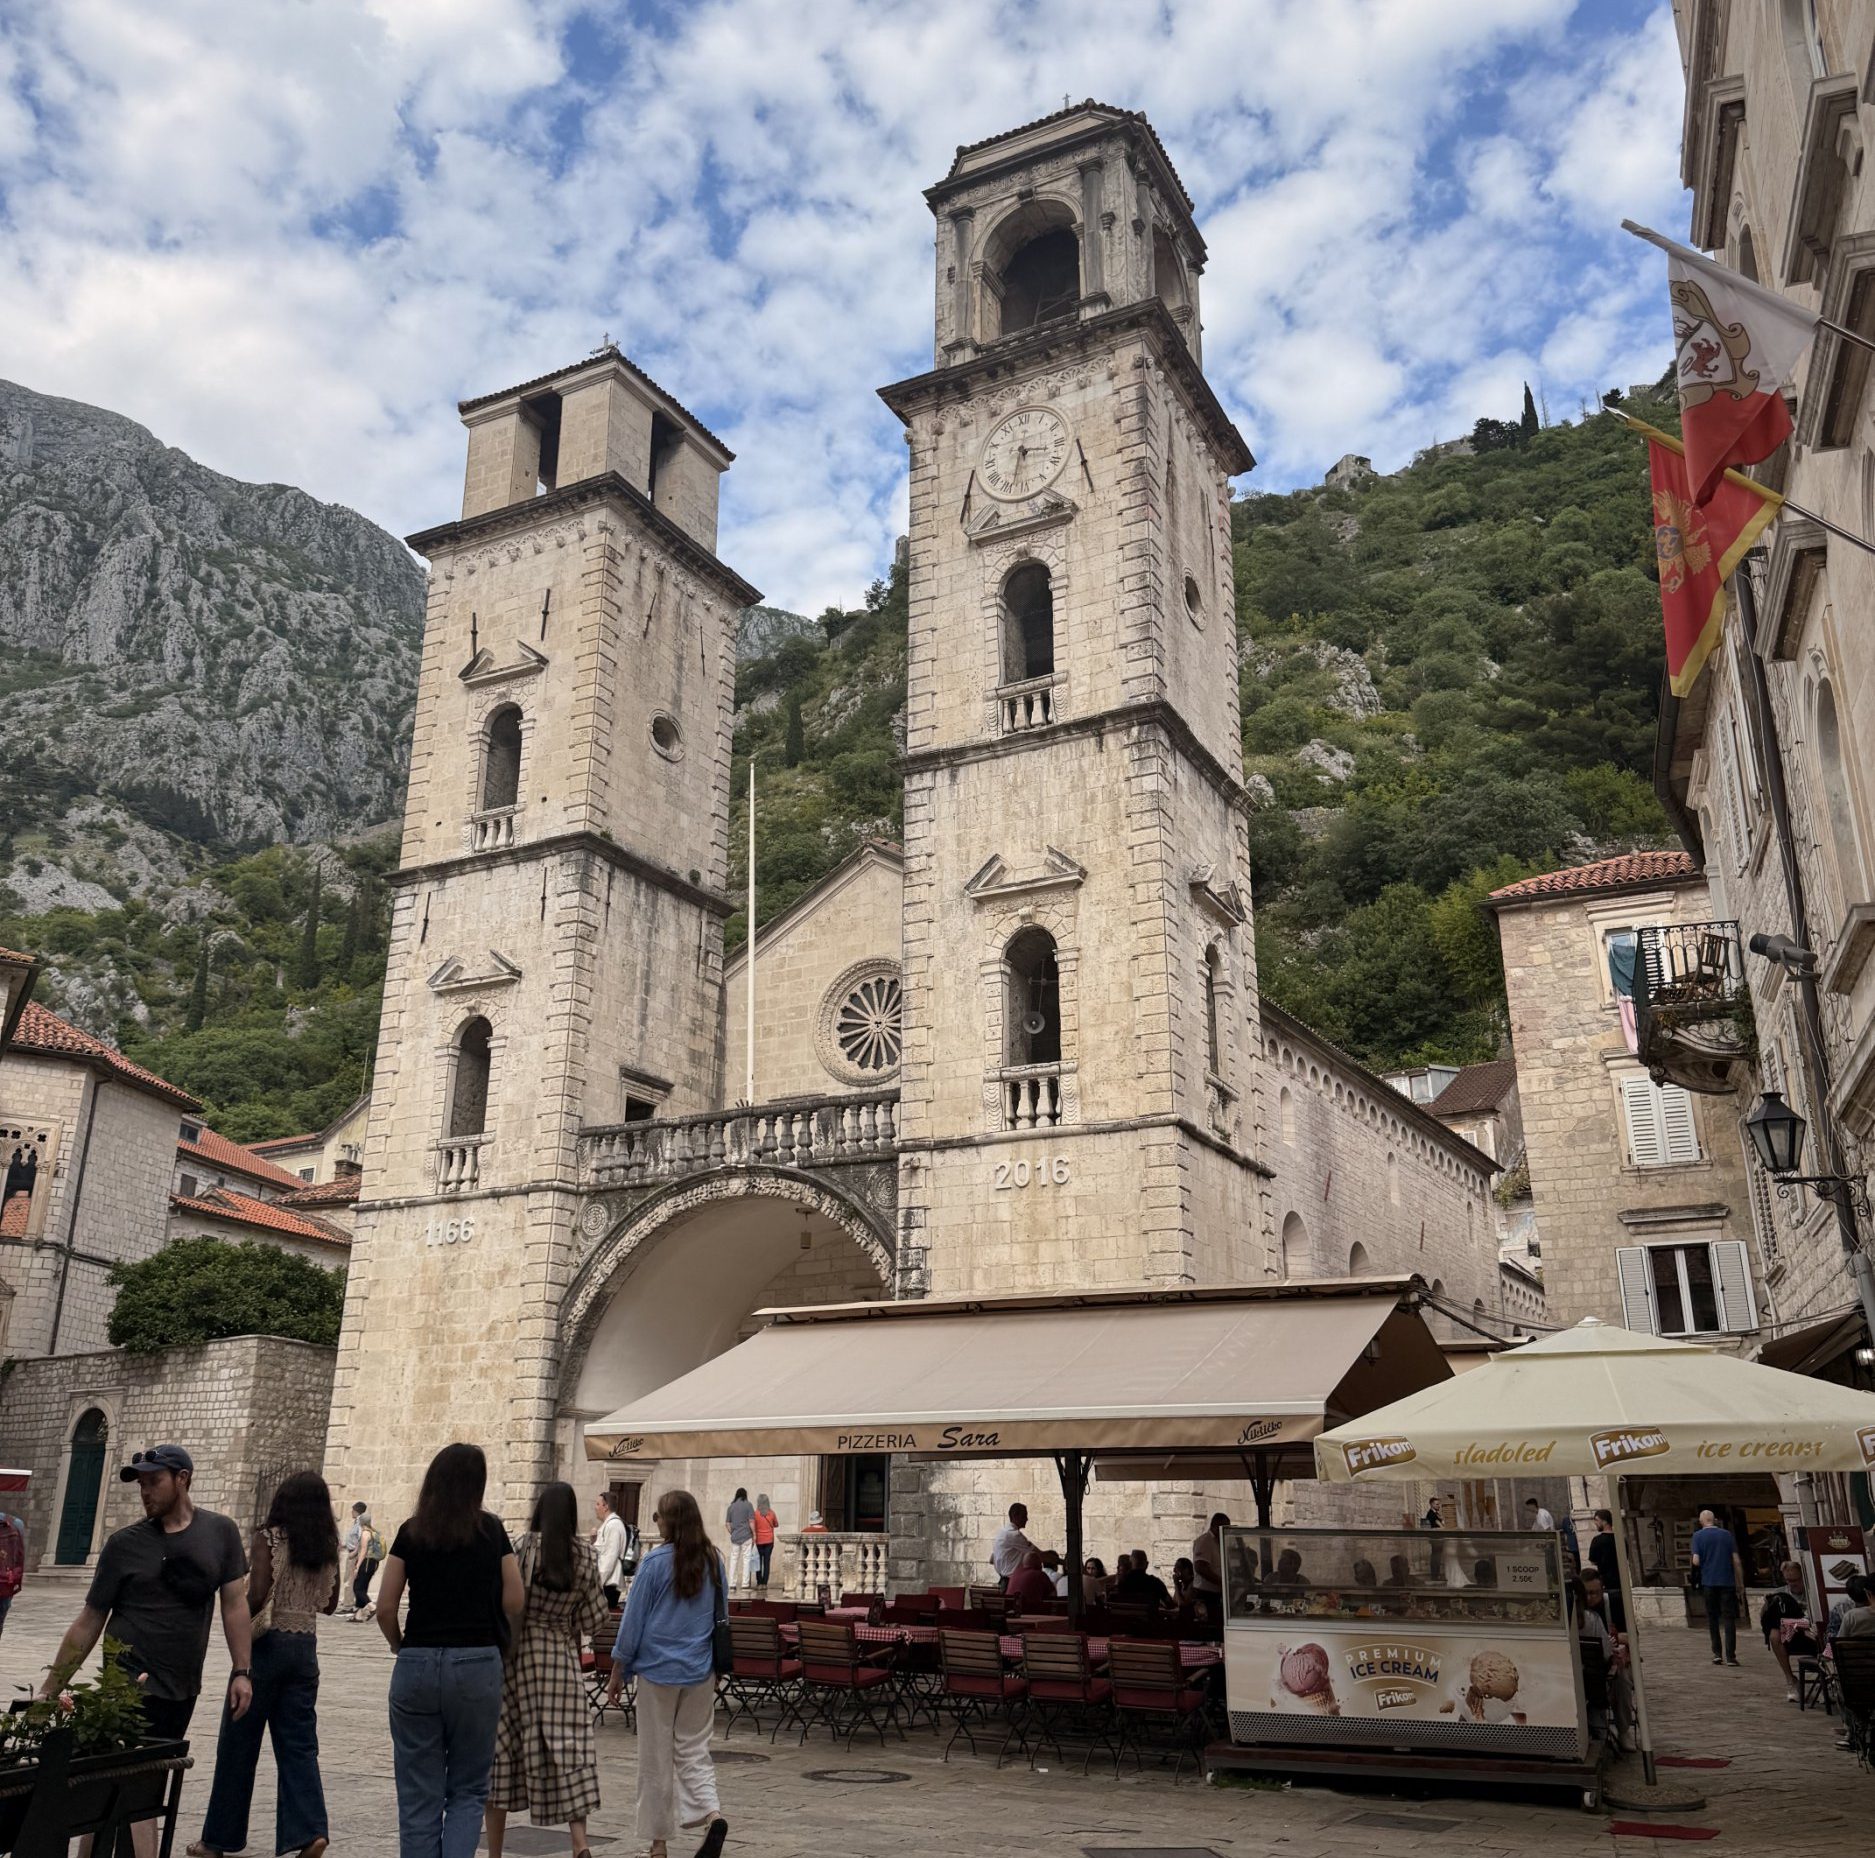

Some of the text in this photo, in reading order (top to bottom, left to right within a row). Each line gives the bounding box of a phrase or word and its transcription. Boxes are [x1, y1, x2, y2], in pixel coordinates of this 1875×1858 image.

[1018, 413, 1030, 426] XII
[1049, 421, 1060, 432] II
[1001, 422, 1013, 436] XI
[990, 441, 1000, 449] X
[1054, 436, 1065, 447] III
[985, 458, 996, 470] IX
[994, 1155, 1070, 1190] 2016
[425, 1216, 475, 1247] 1166
[838, 1426, 1000, 1449] PIZZERIA Sara
[1348, 1430, 1824, 1468] Frikom sladoled Frikom ice cream
[1344, 1647, 1441, 1668] PREMIUM
[1350, 1660, 1439, 1683] ICE CREAM
